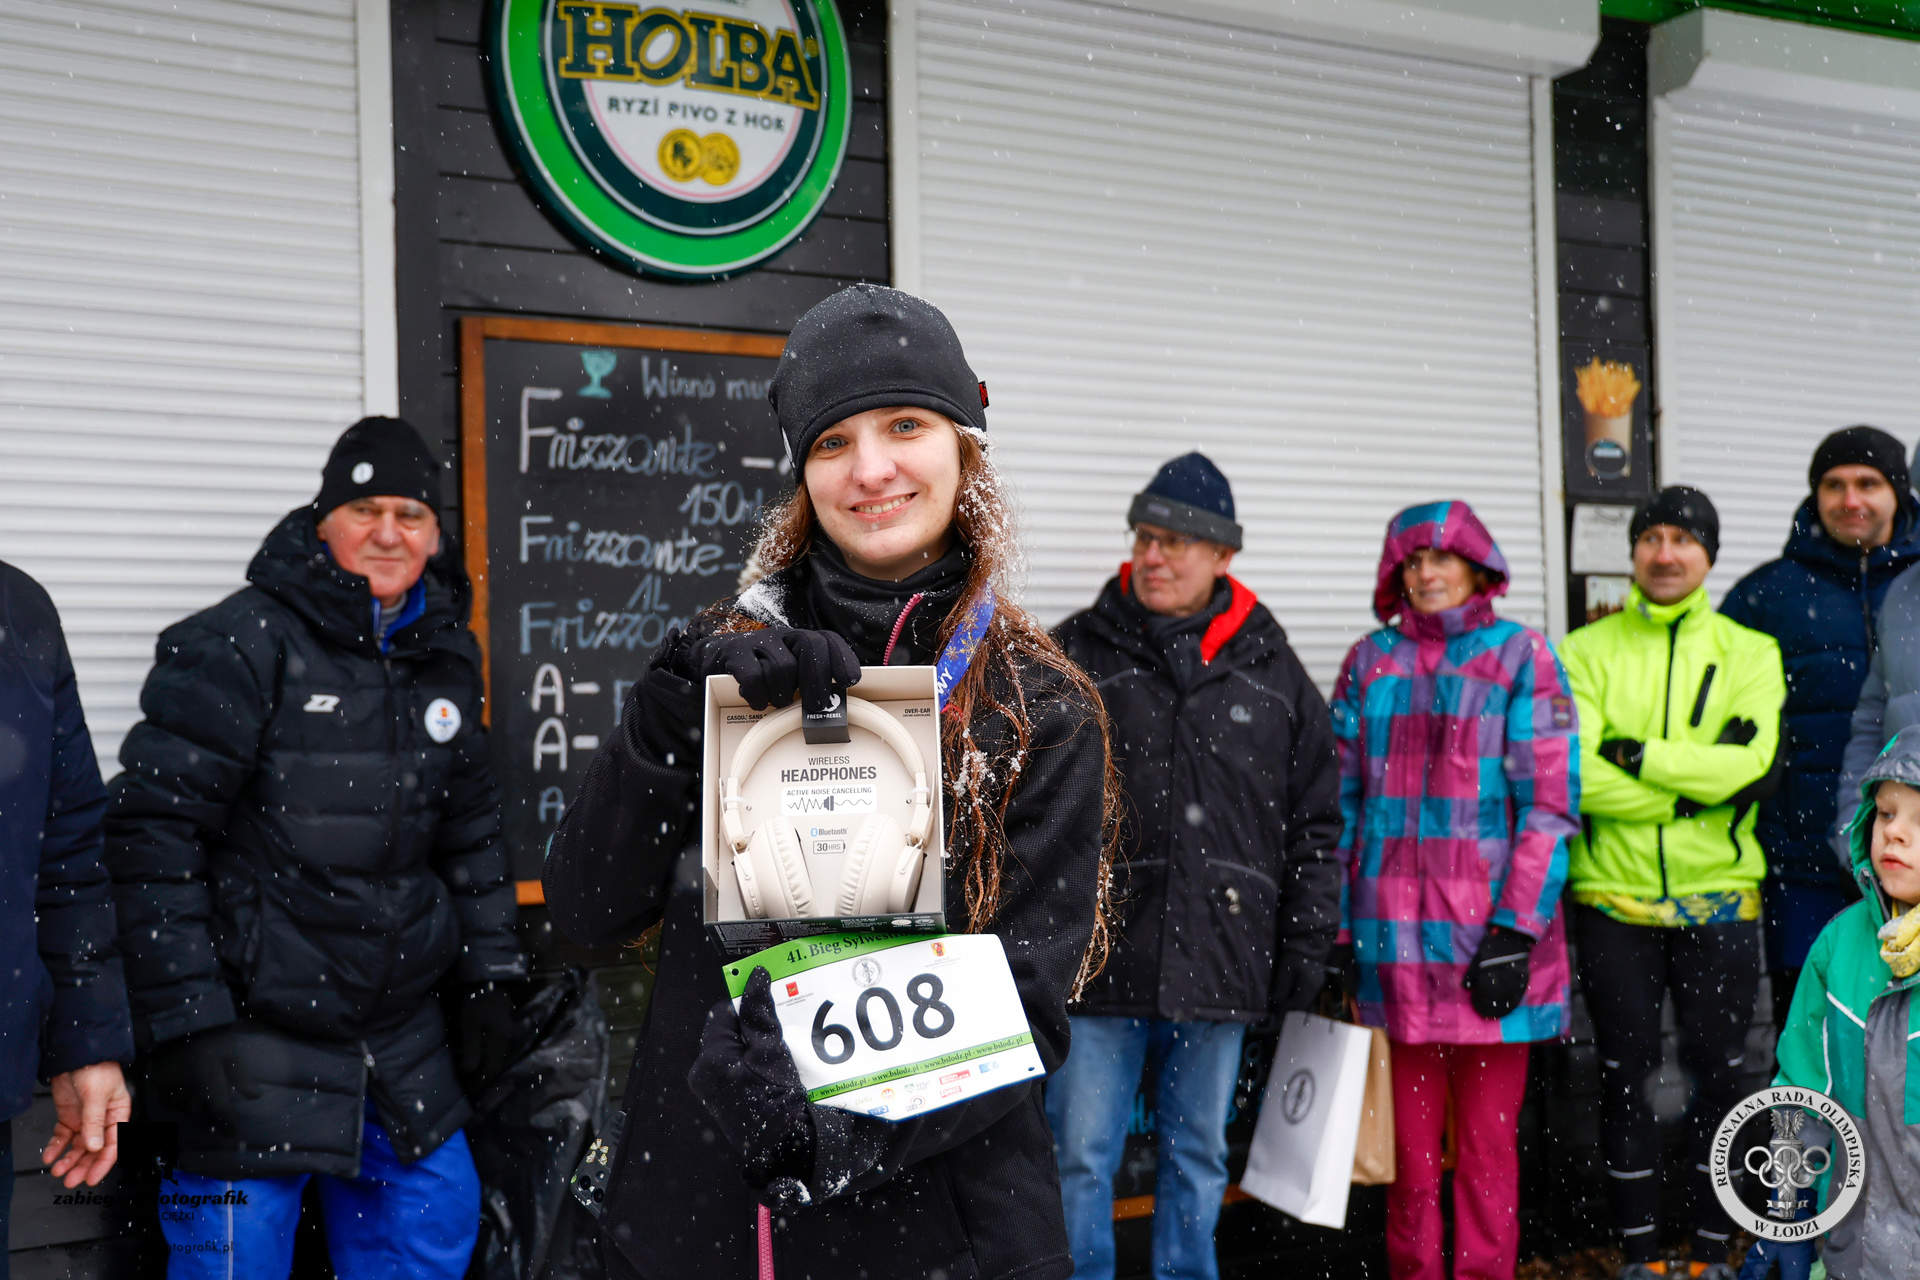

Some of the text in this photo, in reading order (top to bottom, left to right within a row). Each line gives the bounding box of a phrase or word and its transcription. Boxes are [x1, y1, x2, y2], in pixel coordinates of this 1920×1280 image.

[558, 1, 820, 112] HOLBA
[607, 96, 786, 132] RYZÍ PIVO Z HOR
[519, 386, 718, 478] Frizzante
[781, 766, 877, 783] HEADPHONES
[808, 756, 850, 766] WIRELESS
[787, 949, 807, 963] 41.
[809, 941, 842, 957] Bieg
[811, 972, 955, 1065] 608
